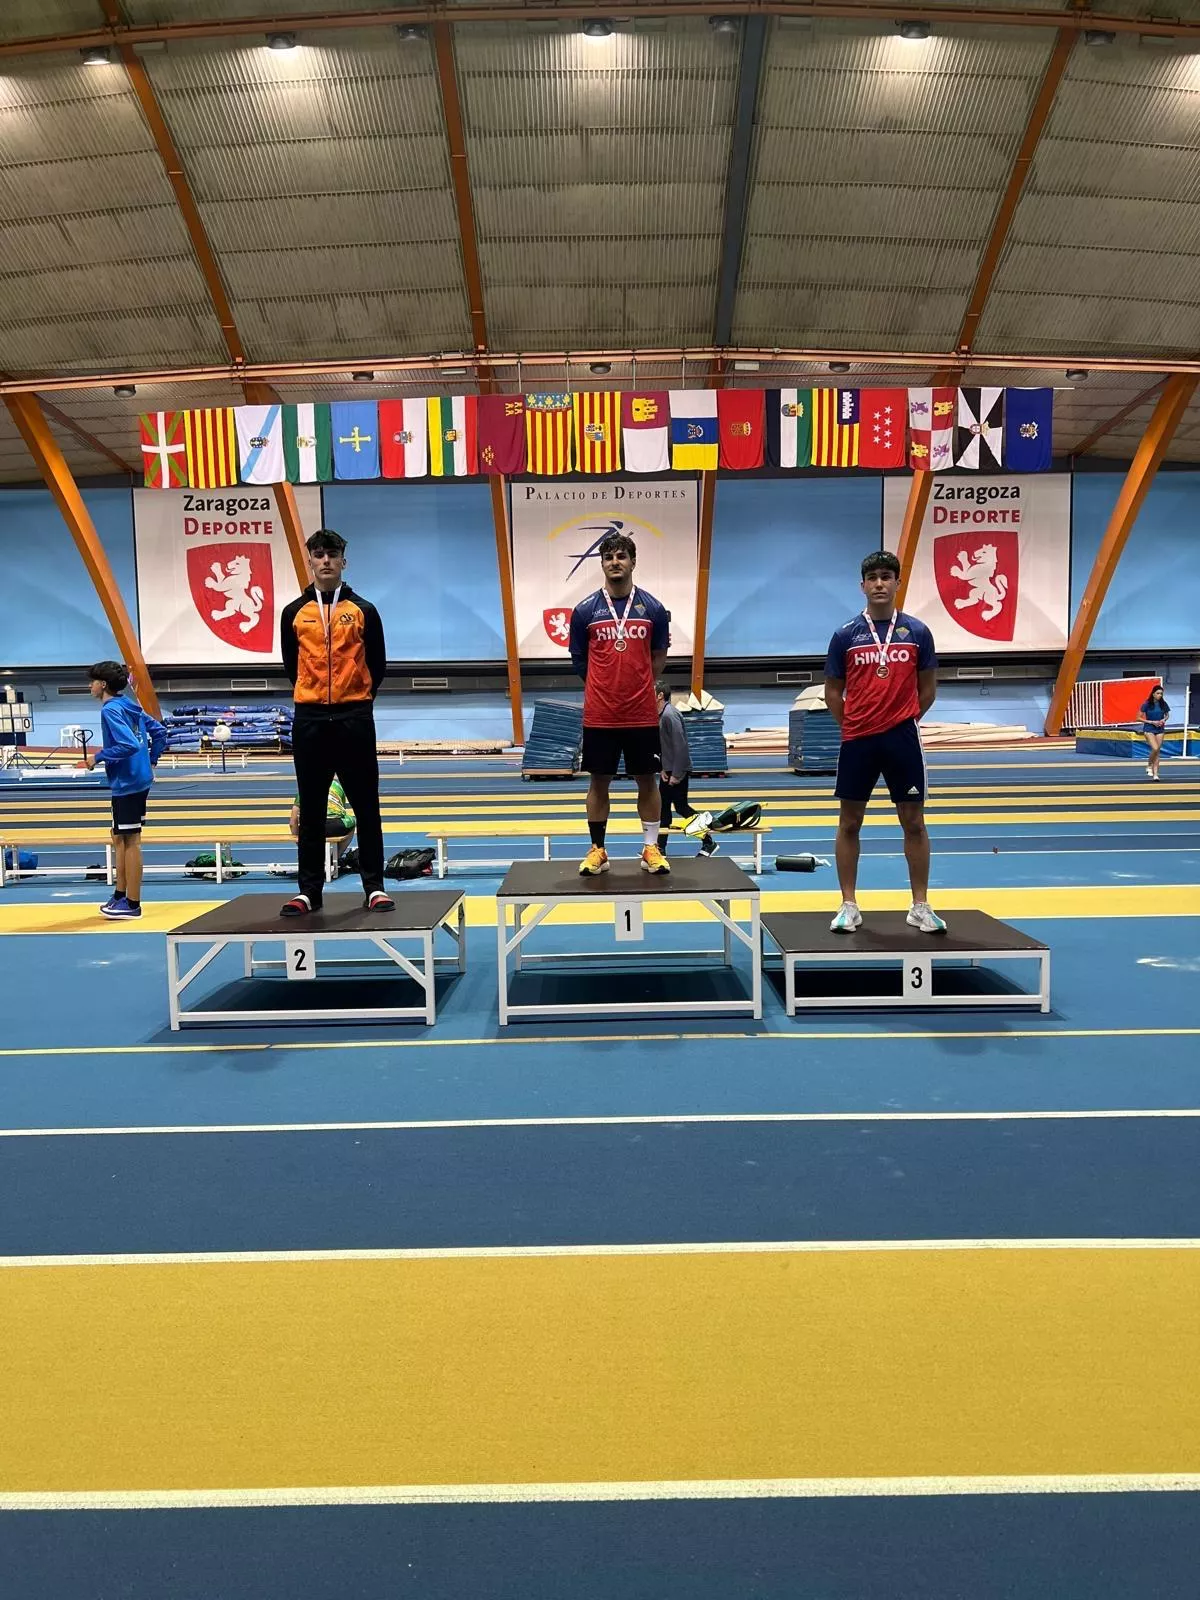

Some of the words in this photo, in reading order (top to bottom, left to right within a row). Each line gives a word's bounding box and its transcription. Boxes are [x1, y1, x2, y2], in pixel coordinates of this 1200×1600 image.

[525, 486, 586, 500] PALACIO
[592, 491, 608, 500] DE
[614, 486, 686, 499] DEPORTES
[934, 483, 1020, 504] Zaragoza
[183, 494, 270, 516] Zaragoza
[933, 506, 1020, 524] DEPORTE
[184, 517, 273, 535] DEPORTE
[624, 909, 631, 932] 1
[294, 948, 307, 972] 2
[911, 966, 923, 989] 3
